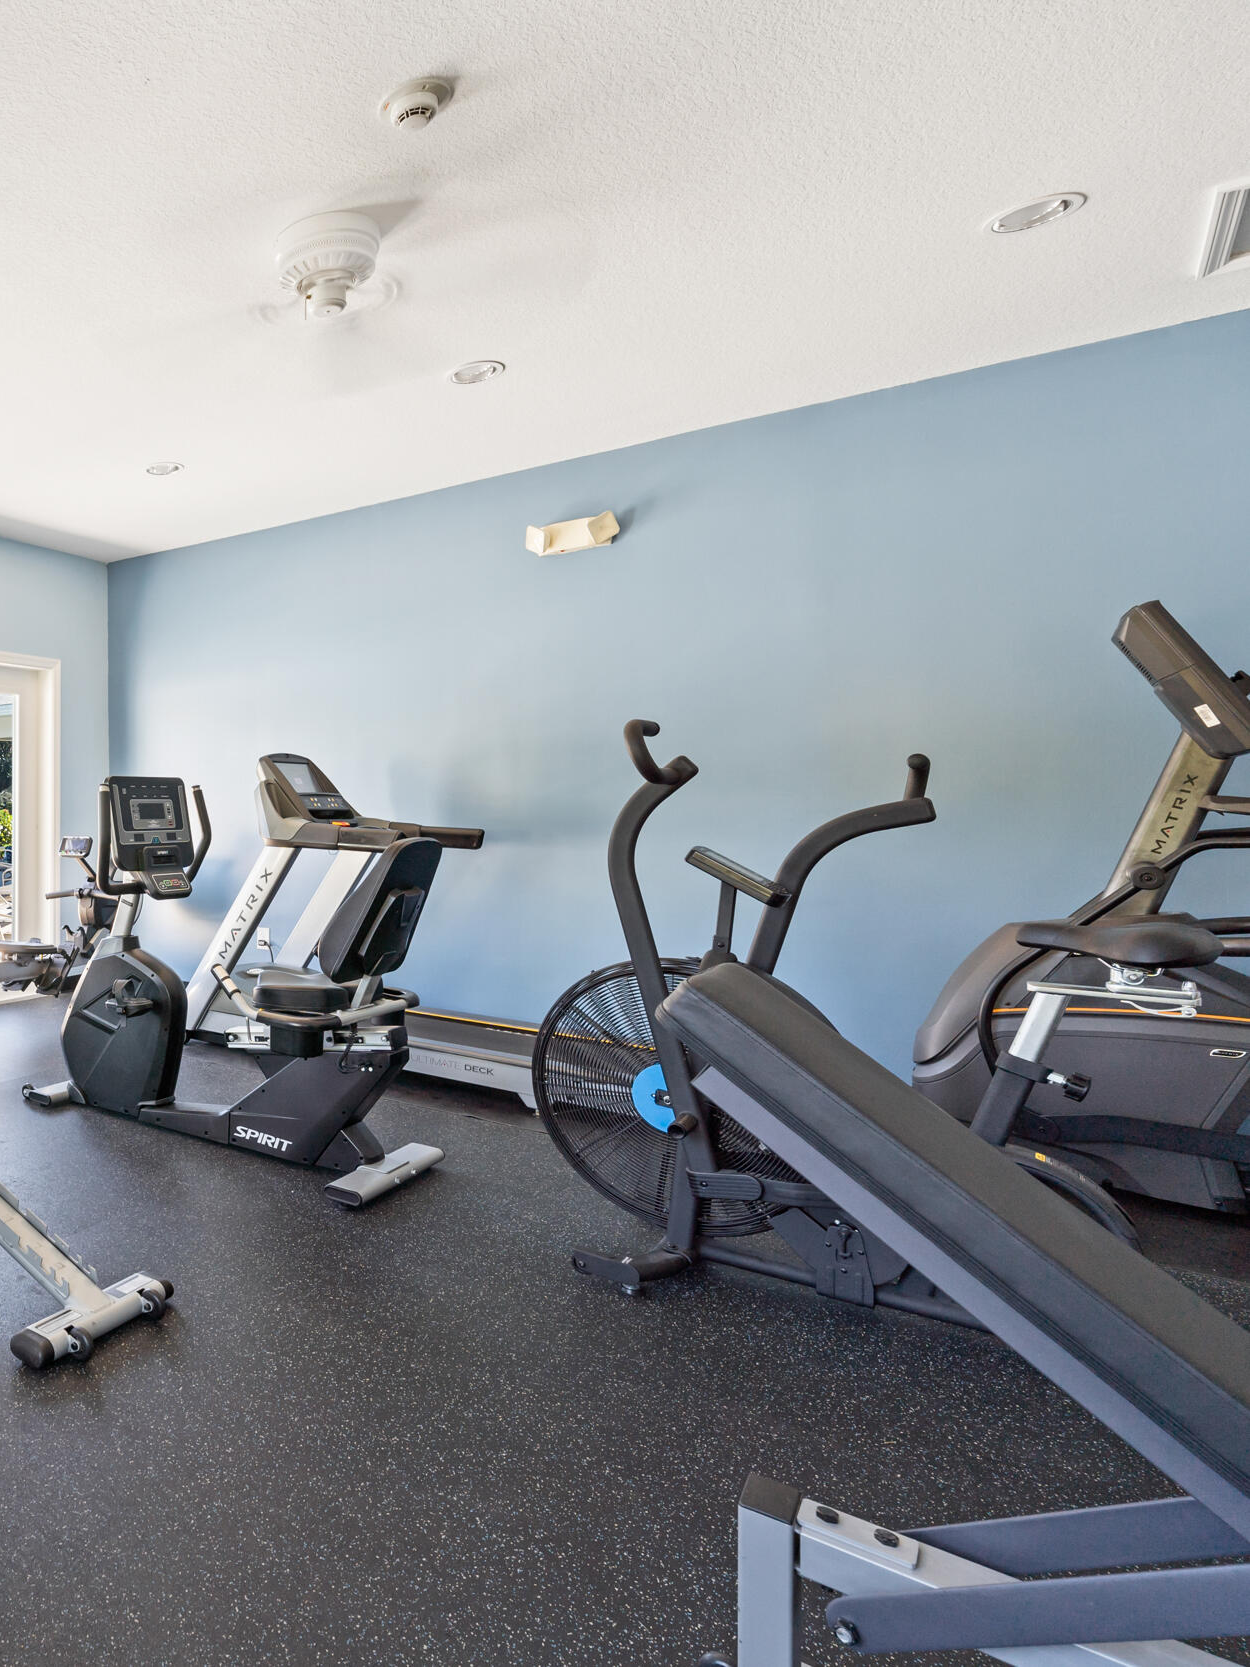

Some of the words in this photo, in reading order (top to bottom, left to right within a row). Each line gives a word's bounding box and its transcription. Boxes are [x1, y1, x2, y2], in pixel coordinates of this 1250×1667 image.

[1151, 774, 1199, 855] MATRIX
[218, 867, 273, 960] MATRIX
[410, 1053, 462, 1070] ULTIMATE
[464, 1063, 494, 1076] DECK
[234, 1125, 293, 1152] SPIRIT
